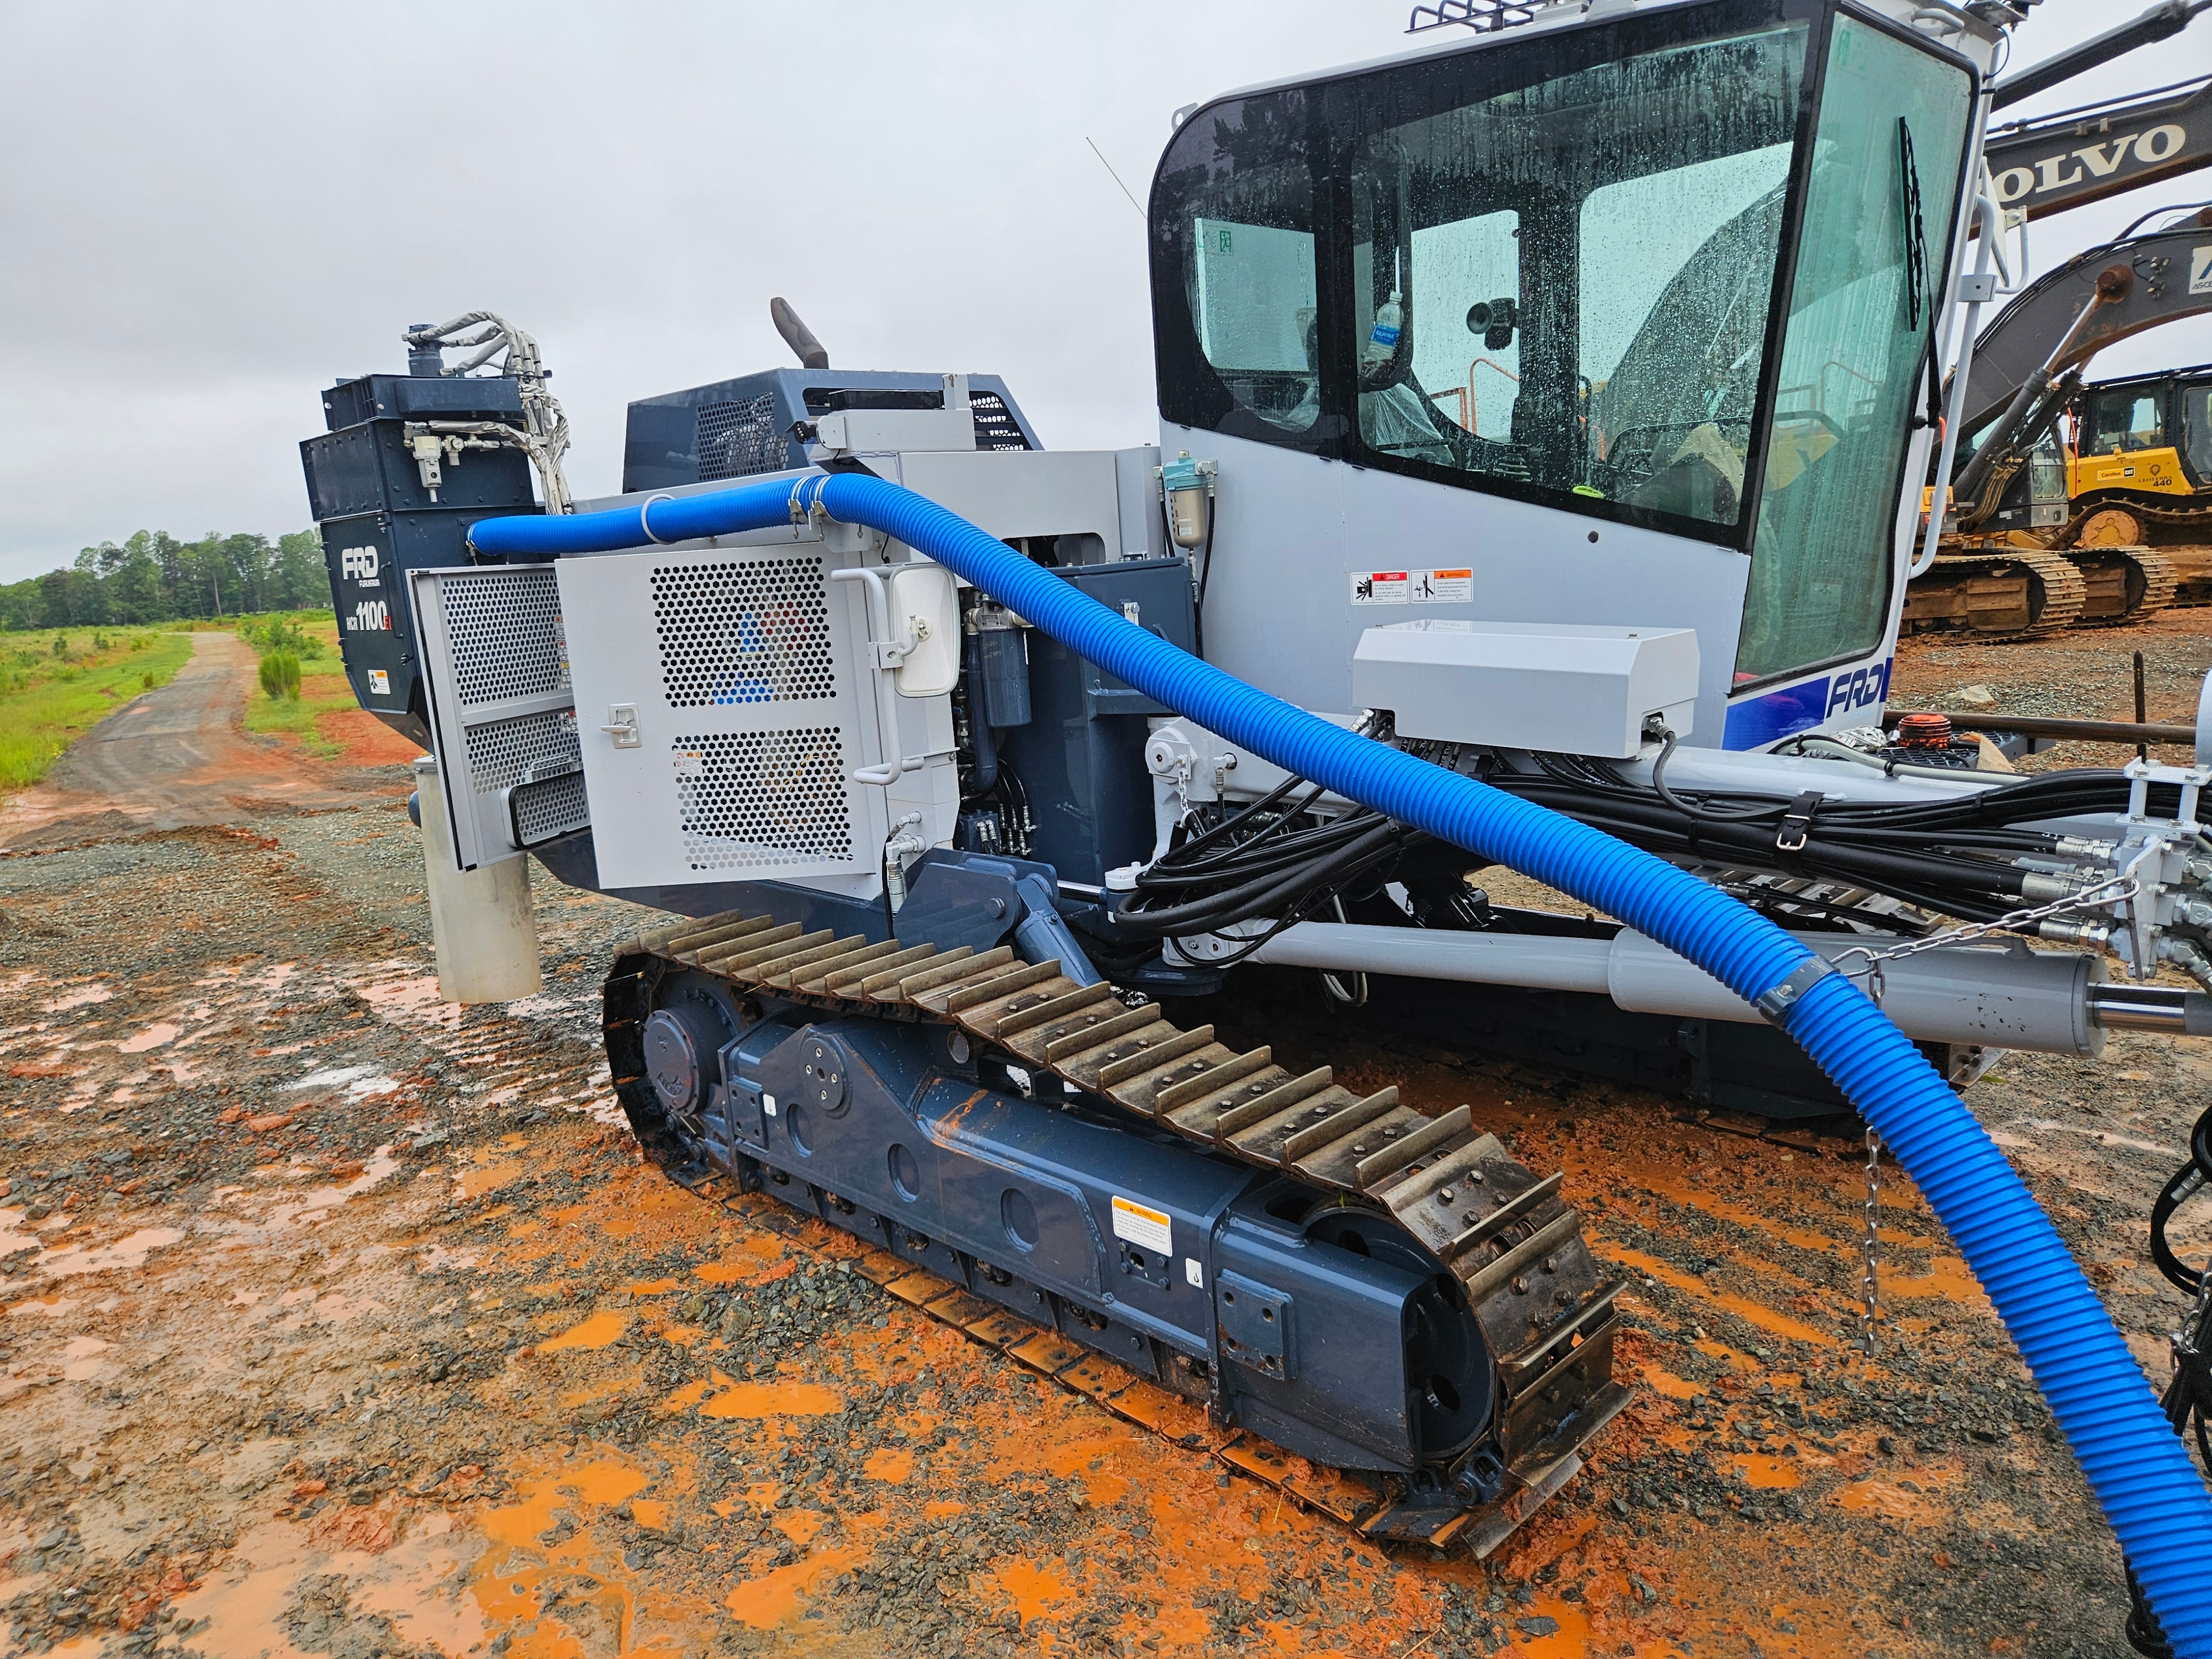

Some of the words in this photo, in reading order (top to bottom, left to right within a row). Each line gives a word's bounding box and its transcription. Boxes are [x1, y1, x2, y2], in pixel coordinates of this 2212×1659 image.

[1977, 124, 2186, 202] OLVO
[342, 546, 378, 579] FRD
[1825, 663, 1884, 719] FRD
